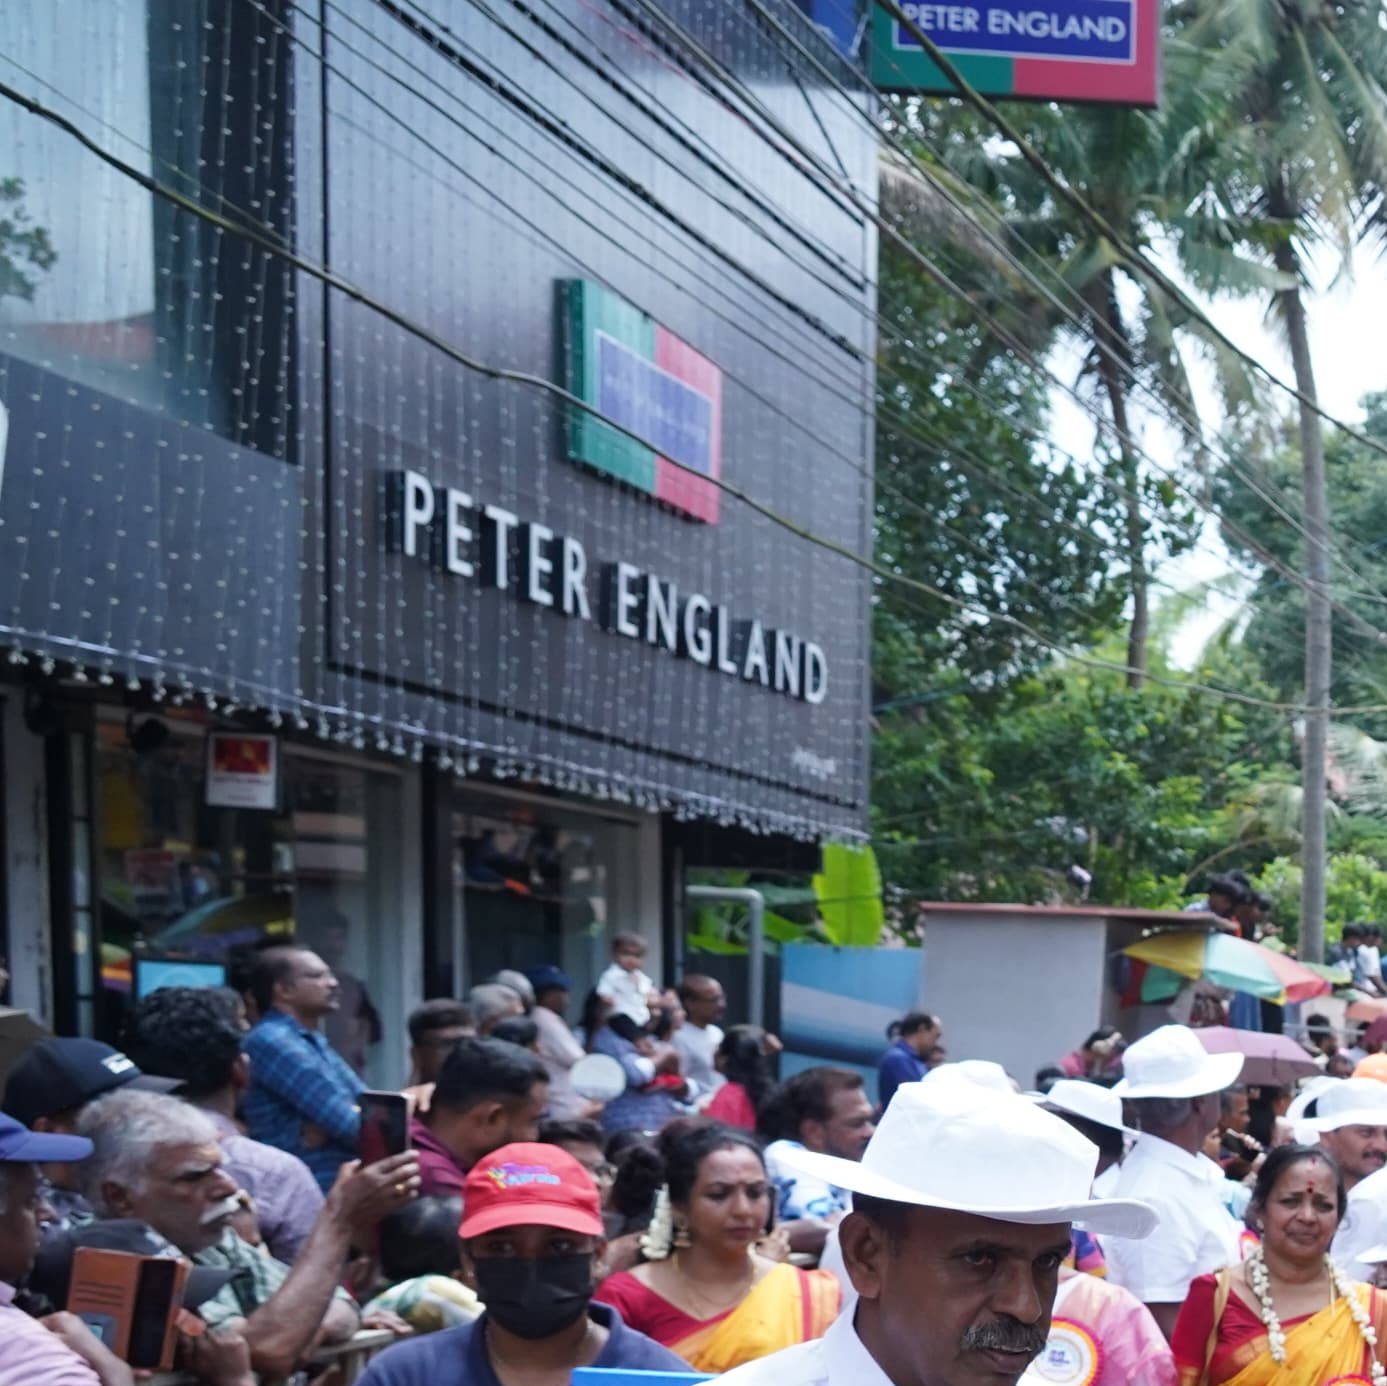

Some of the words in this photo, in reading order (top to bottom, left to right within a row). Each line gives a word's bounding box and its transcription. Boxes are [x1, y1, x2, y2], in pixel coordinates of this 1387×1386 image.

[904, 3, 981, 33] PETER
[987, 8, 1128, 43] ENGLAND
[401, 470, 593, 621] PETER
[615, 562, 832, 706] ENGLAND
